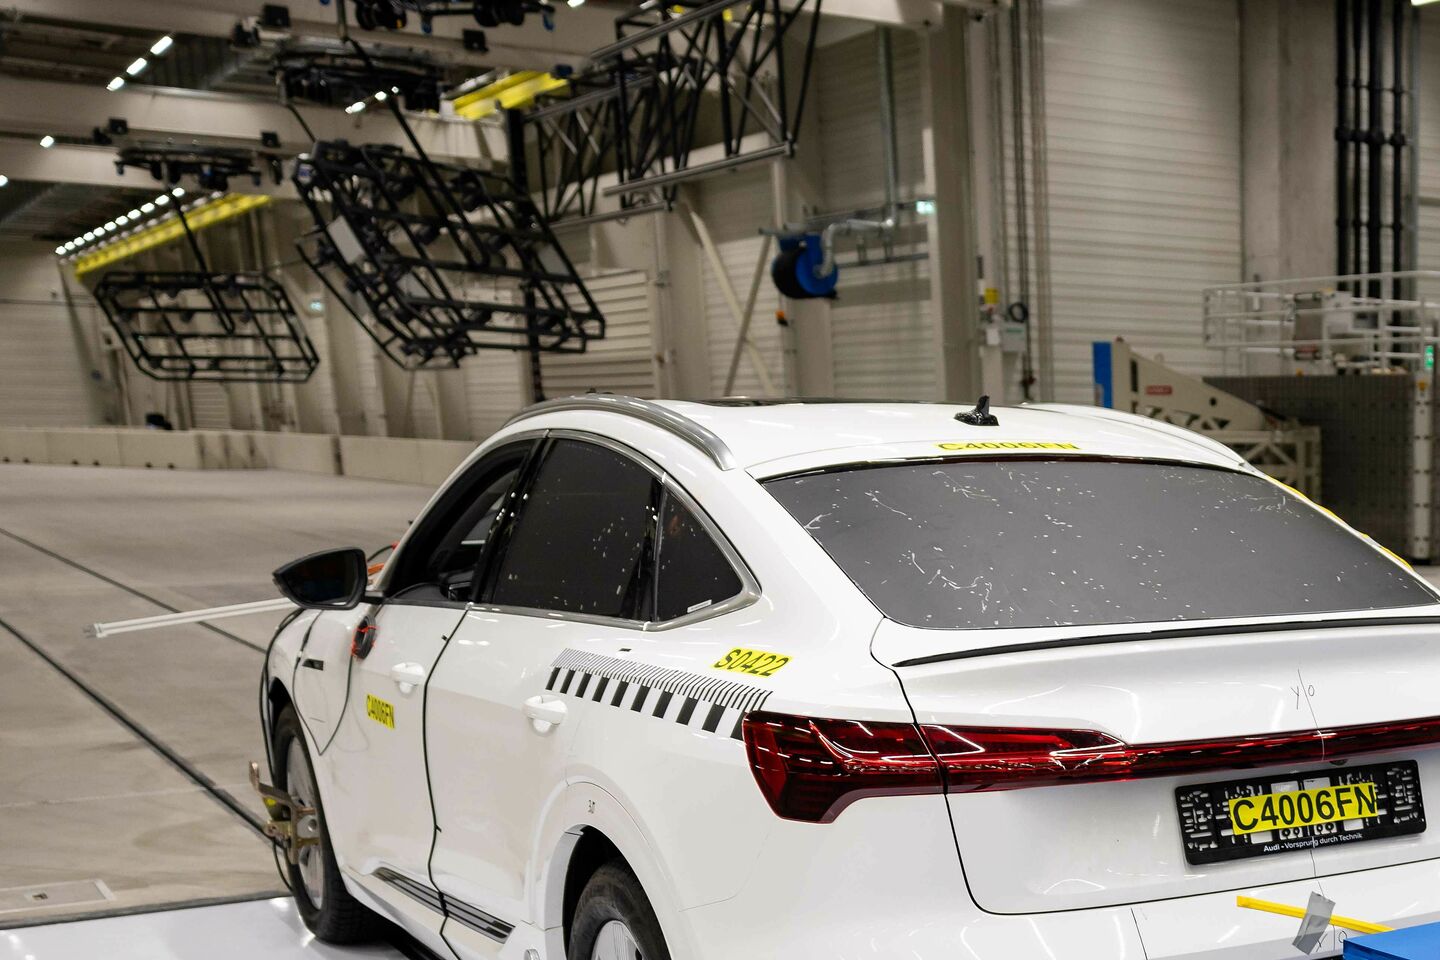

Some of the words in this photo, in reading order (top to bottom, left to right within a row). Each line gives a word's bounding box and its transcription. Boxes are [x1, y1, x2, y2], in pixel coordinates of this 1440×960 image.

[713, 648, 789, 677] S0422
[1232, 783, 1377, 831] C4006FN
[1263, 844, 1280, 853] Audi
[1284, 837, 1319, 849] Vorsprung
[1319, 834, 1339, 845] durch
[1339, 832, 1363, 841] Technik
